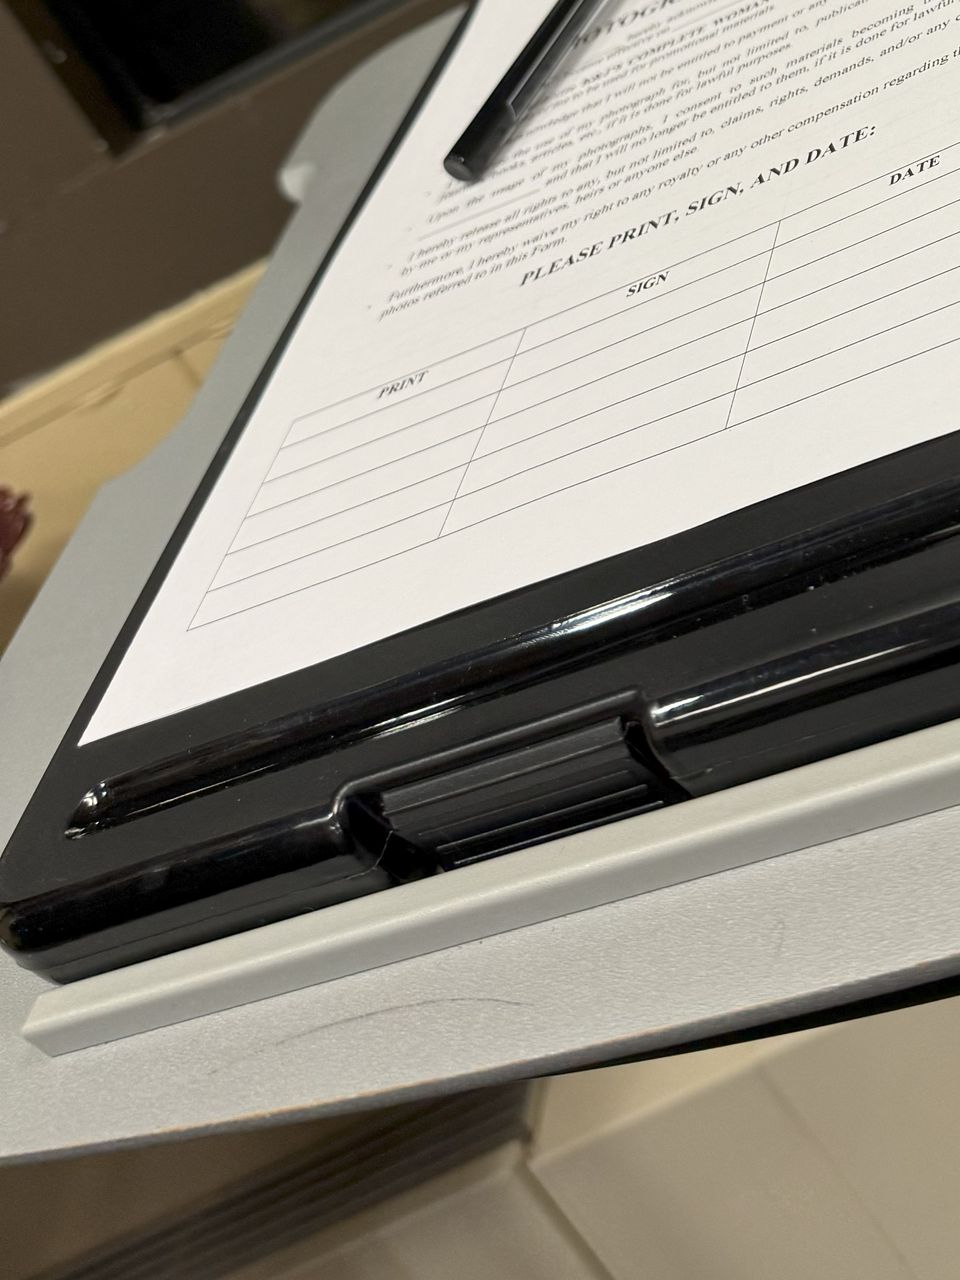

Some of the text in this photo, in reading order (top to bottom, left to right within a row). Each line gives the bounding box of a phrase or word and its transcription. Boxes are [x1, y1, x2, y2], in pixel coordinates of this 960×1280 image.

[736, 11, 790, 45] payment
[791, 6, 804, 18] or
[775, 59, 813, 87] them,
[813, 53, 827, 68] if
[827, 48, 838, 61] it
[840, 41, 853, 55] is
[854, 25, 888, 49] done
[889, 15, 910, 33] for
[785, 33, 845, 69] materials
[850, 0, 915, 42] becoming
[719, 100, 767, 132] claims,
[768, 81, 810, 111] rights,
[812, 50, 876, 90] demands,
[879, 28, 923, 58] and/or
[925, 18, 950, 39] any
[655, 160, 704, 194] royalty
[706, 155, 722, 169] or
[721, 143, 747, 164] any
[749, 124, 786, 149] other
[785, 81, 880, 136] compensation
[882, 49, 950, 93] regarding
[517, 120, 878, 288] PLEASE PRINT, SIGN, AND DATE:
[888, 153, 941, 187] DATE
[625, 268, 670, 298] SIGN
[375, 368, 430, 401] PRINT
